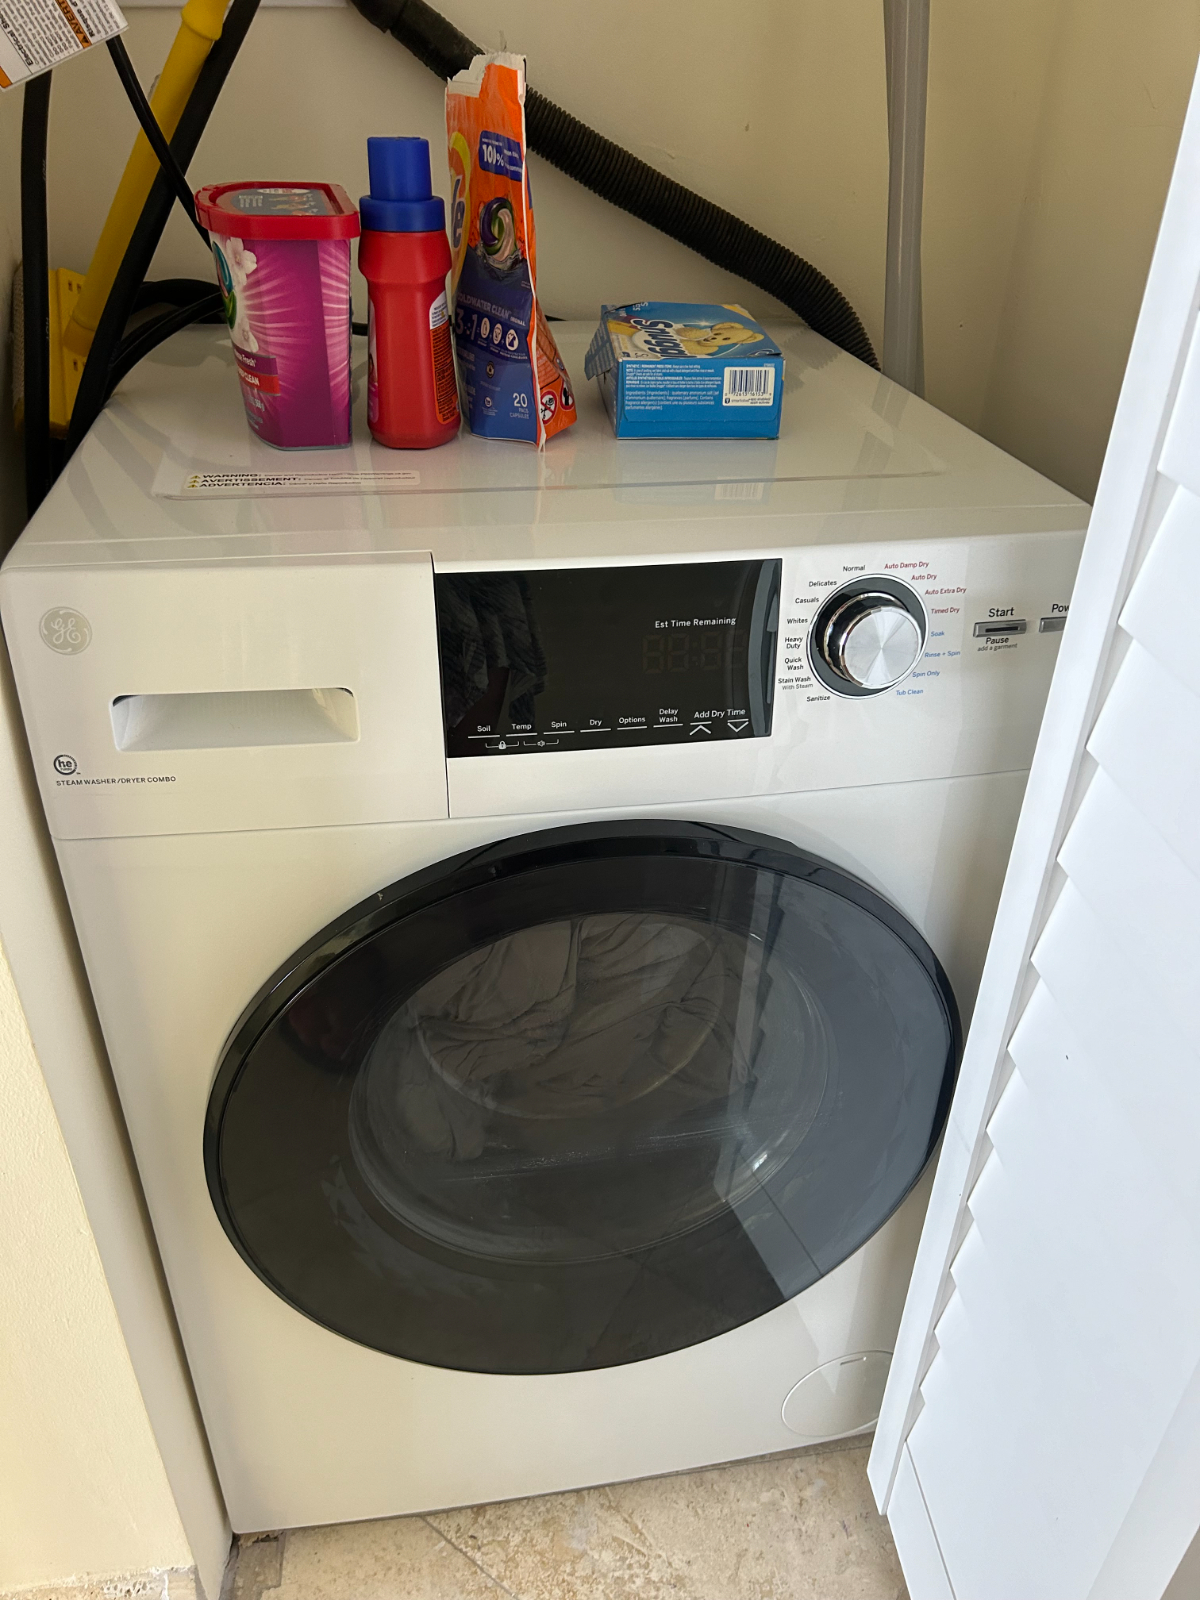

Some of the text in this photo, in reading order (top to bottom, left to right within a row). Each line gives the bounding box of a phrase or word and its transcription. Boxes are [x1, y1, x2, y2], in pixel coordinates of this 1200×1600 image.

[74, 7, 96, 37] Risque
[7, 29, 33, 66] Electrical
[513, 393, 528, 407] 20
[988, 607, 1014, 617] Start
[671, 619, 691, 627] Time
[693, 617, 736, 627] Remaining
[994, 643, 1017, 652] garment
[659, 708, 678, 717] Delay
[711, 709, 725, 718] Dry
[727, 708, 746, 716] Time
[551, 720, 567, 729] Spin
[589, 719, 602, 727] Dry
[619, 716, 646, 725] Options
[511, 723, 532, 732] Temp
[58, 759, 73, 768] he
[84, 777, 145, 785] WASHER/DRYER
